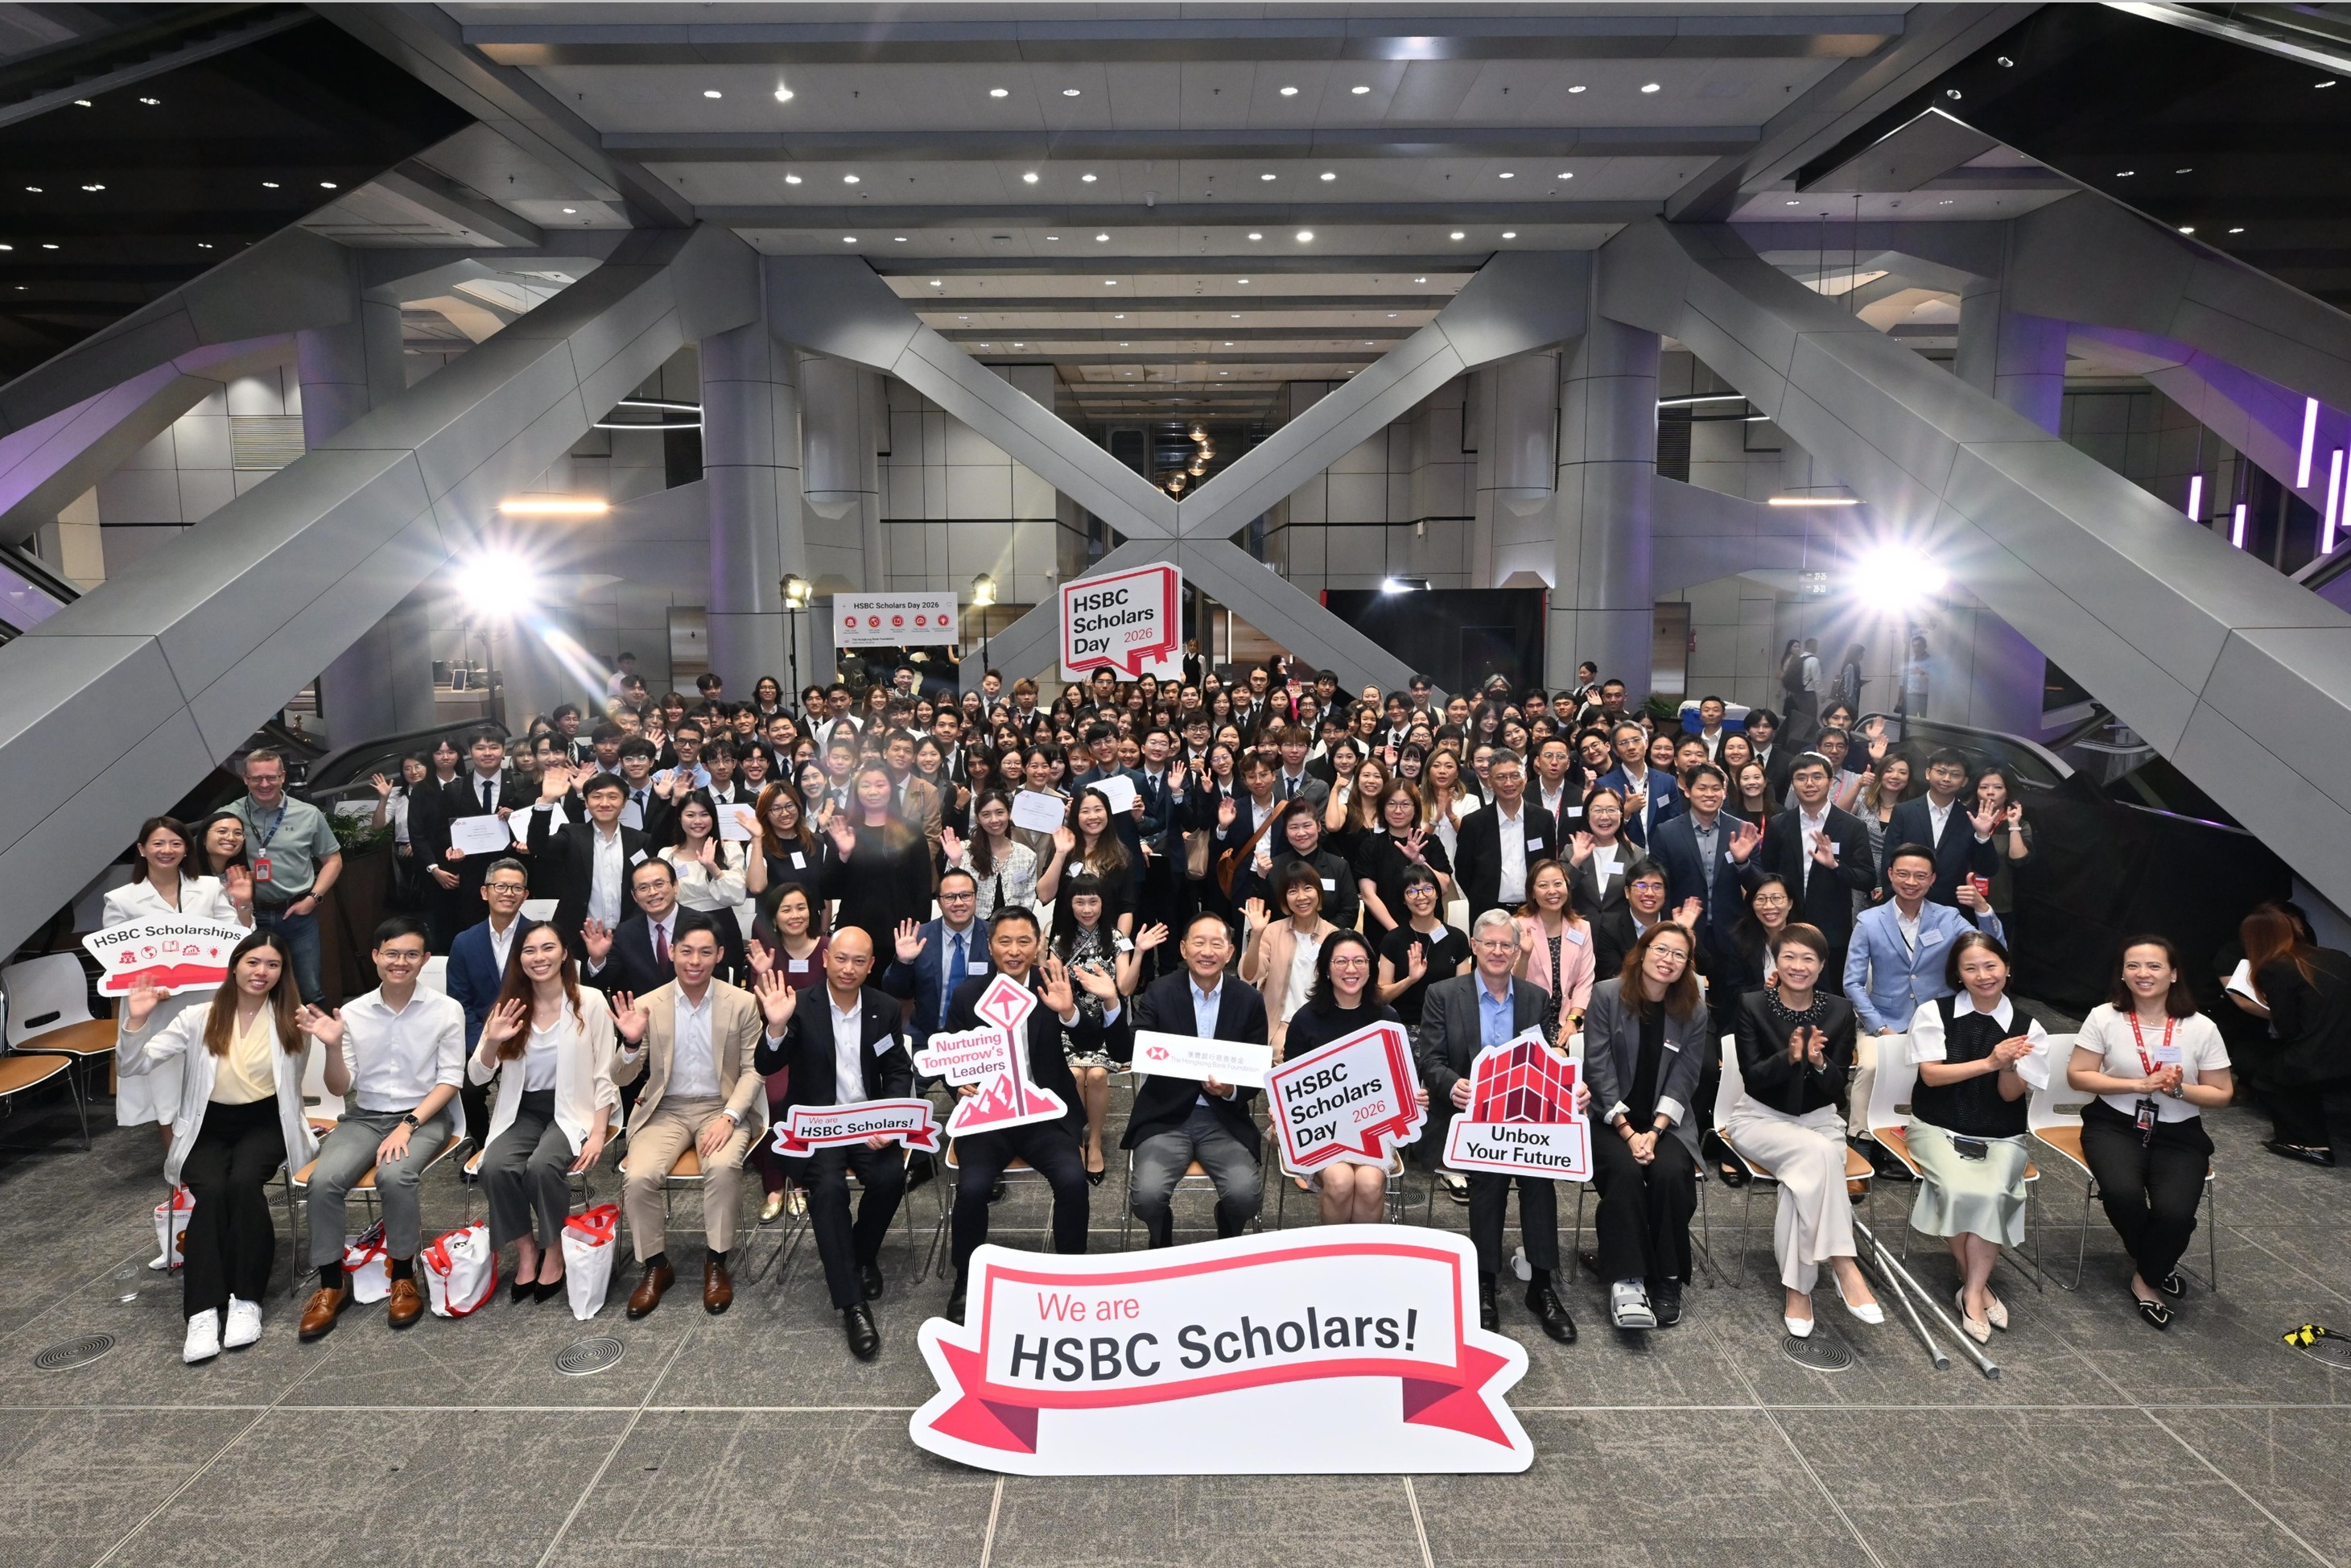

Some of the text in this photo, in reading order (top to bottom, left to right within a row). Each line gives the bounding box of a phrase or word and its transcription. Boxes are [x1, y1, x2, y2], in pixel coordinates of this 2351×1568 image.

[908, 602, 920, 610] Day
[1074, 588, 1128, 613] HSBC
[1073, 608, 1154, 633] Scholars
[1074, 627, 1153, 654] Day 2026
[94, 924, 241, 949] HSBC Scholarships
[936, 1034, 1001, 1053] Nurturing
[922, 1046, 1004, 1069] Tomorrow's
[1170, 1055, 1260, 1072] The Hongkong Bank Foundation
[952, 1062, 1005, 1079] Leaders
[1285, 1063, 1348, 1103] HSBC
[1290, 1079, 1382, 1124] Scholars
[801, 1118, 914, 1137] HSBC Scholars!
[1296, 1100, 1386, 1148] Day 2026
[1491, 1125, 1550, 1146] Unbox
[1466, 1141, 1572, 1167] Your Future
[1037, 1292, 1140, 1322] We are
[1010, 1306, 1417, 1382] HSBC Scholars!
